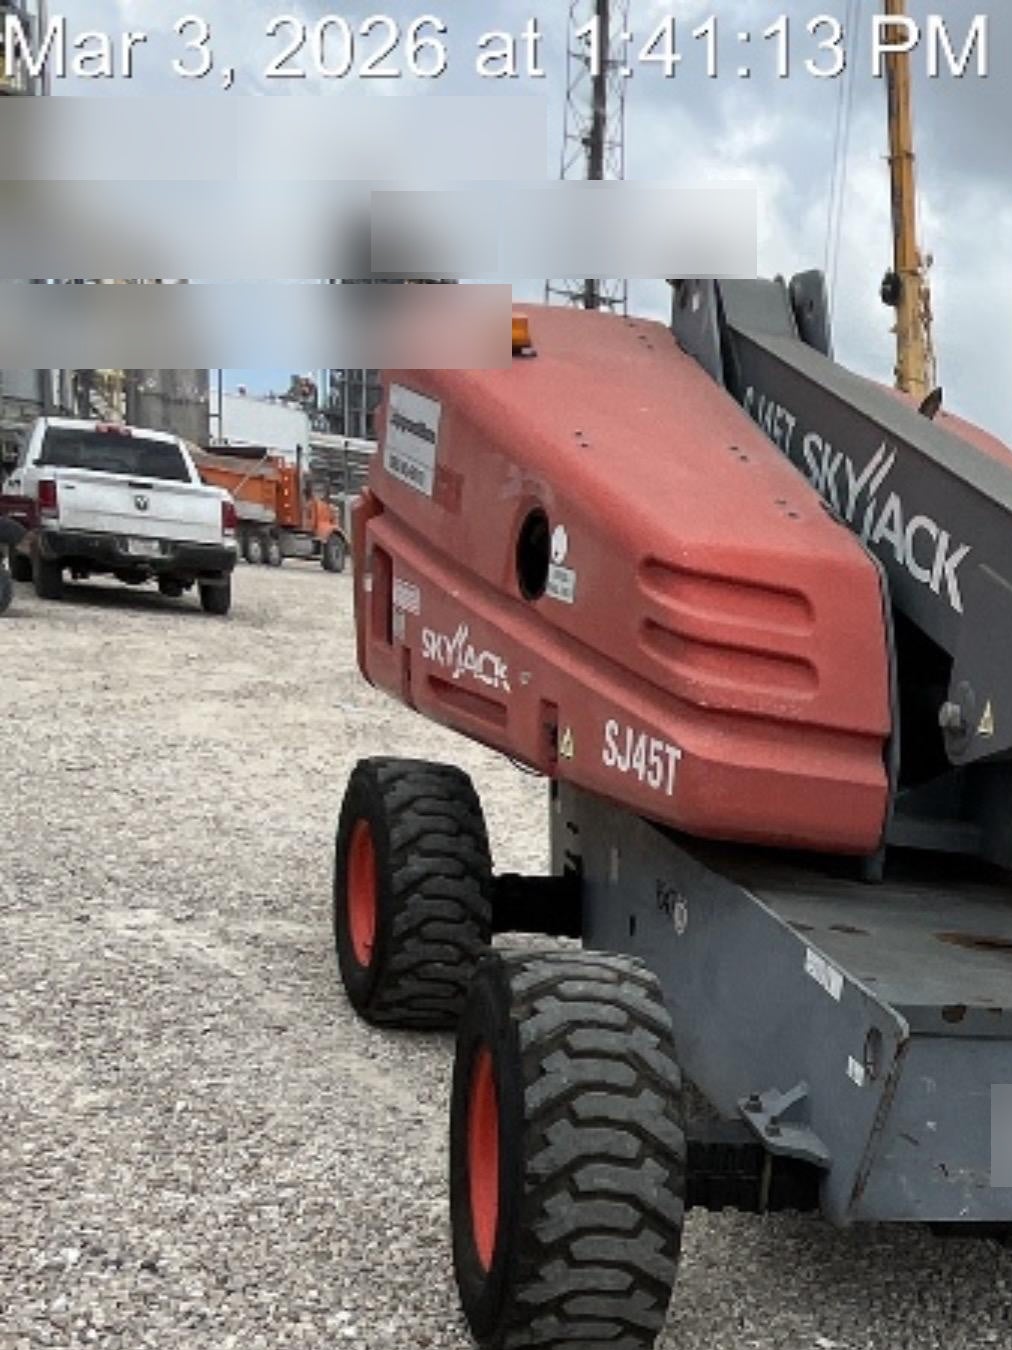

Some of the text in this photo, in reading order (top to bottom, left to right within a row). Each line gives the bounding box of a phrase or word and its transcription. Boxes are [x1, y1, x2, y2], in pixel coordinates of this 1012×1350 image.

[803, 433, 972, 614] SKYJACK
[422, 622, 512, 693] SKYJACK
[602, 719, 682, 796] SJ45T
